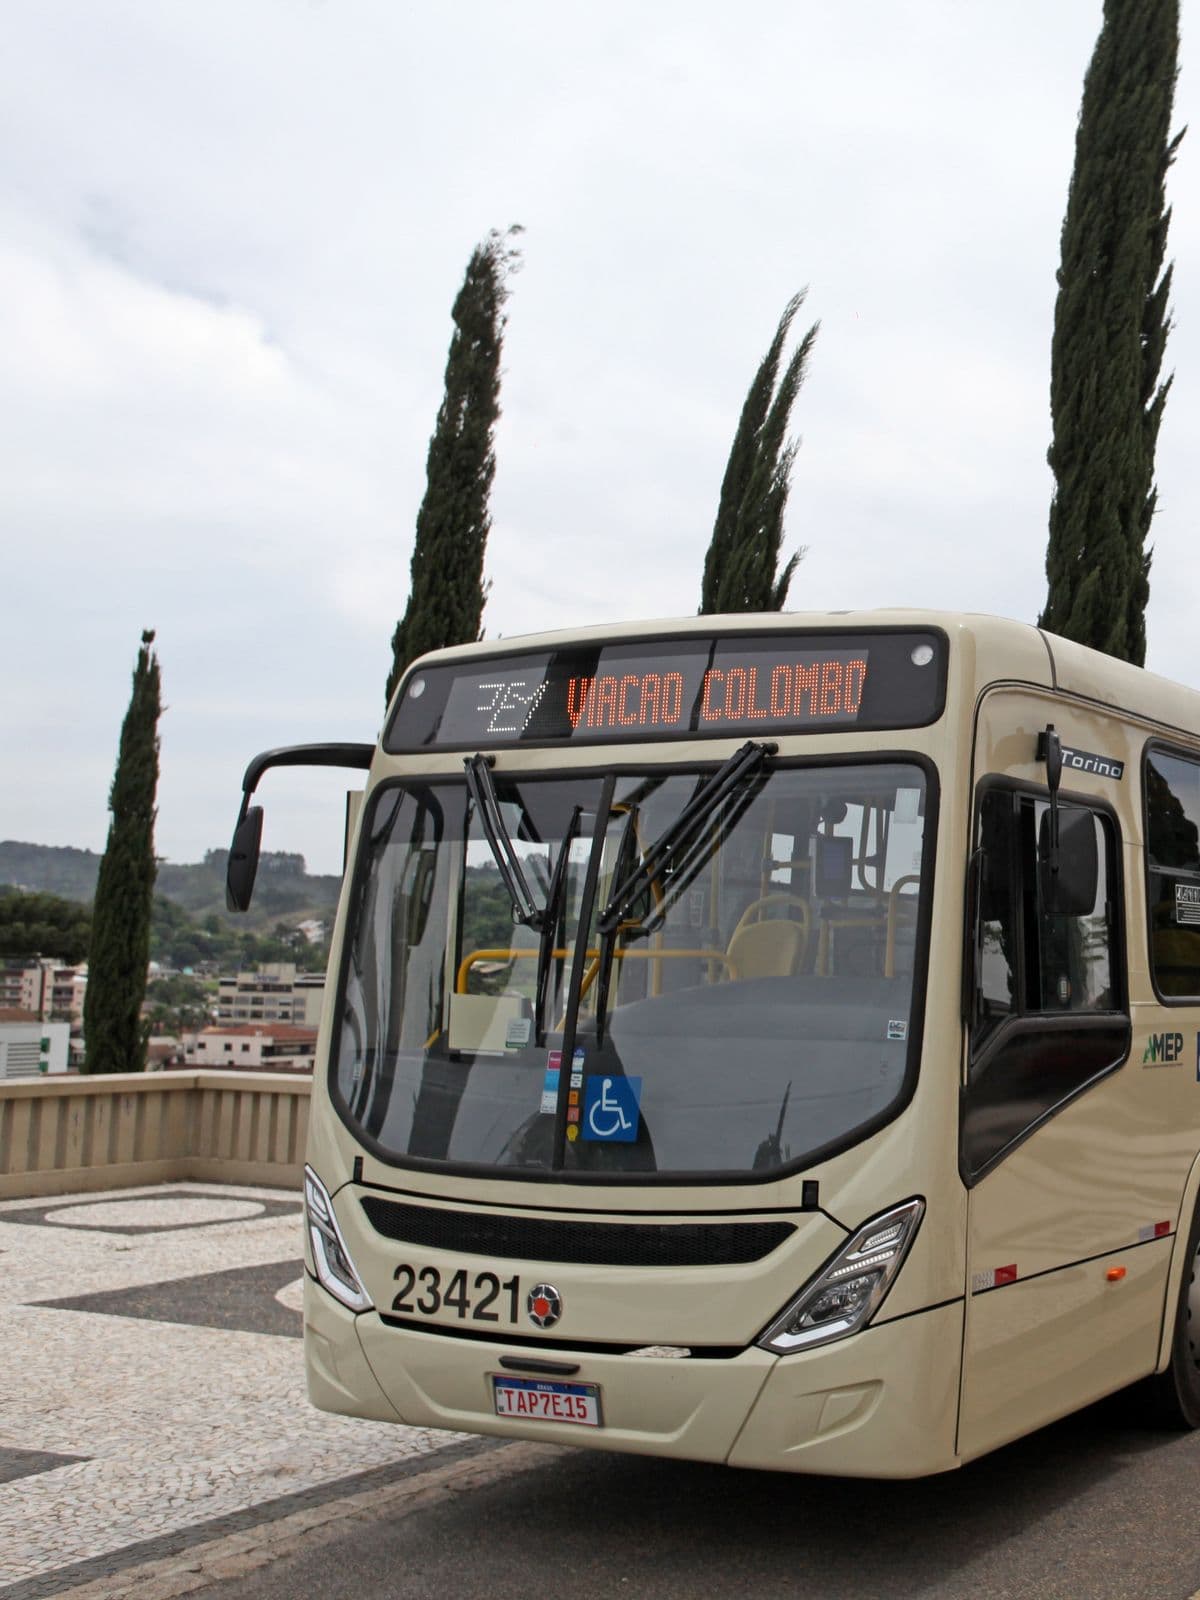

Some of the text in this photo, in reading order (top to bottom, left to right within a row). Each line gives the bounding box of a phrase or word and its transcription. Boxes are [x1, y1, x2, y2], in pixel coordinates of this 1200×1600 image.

[567, 671, 683, 728] VIACAO
[702, 660, 867, 721] COLOMBO
[1061, 749, 1122, 777] Torino
[1143, 1032, 1184, 1064] AMEP
[392, 1263, 521, 1325] 23421
[503, 1389, 587, 1419] TAP7E15
